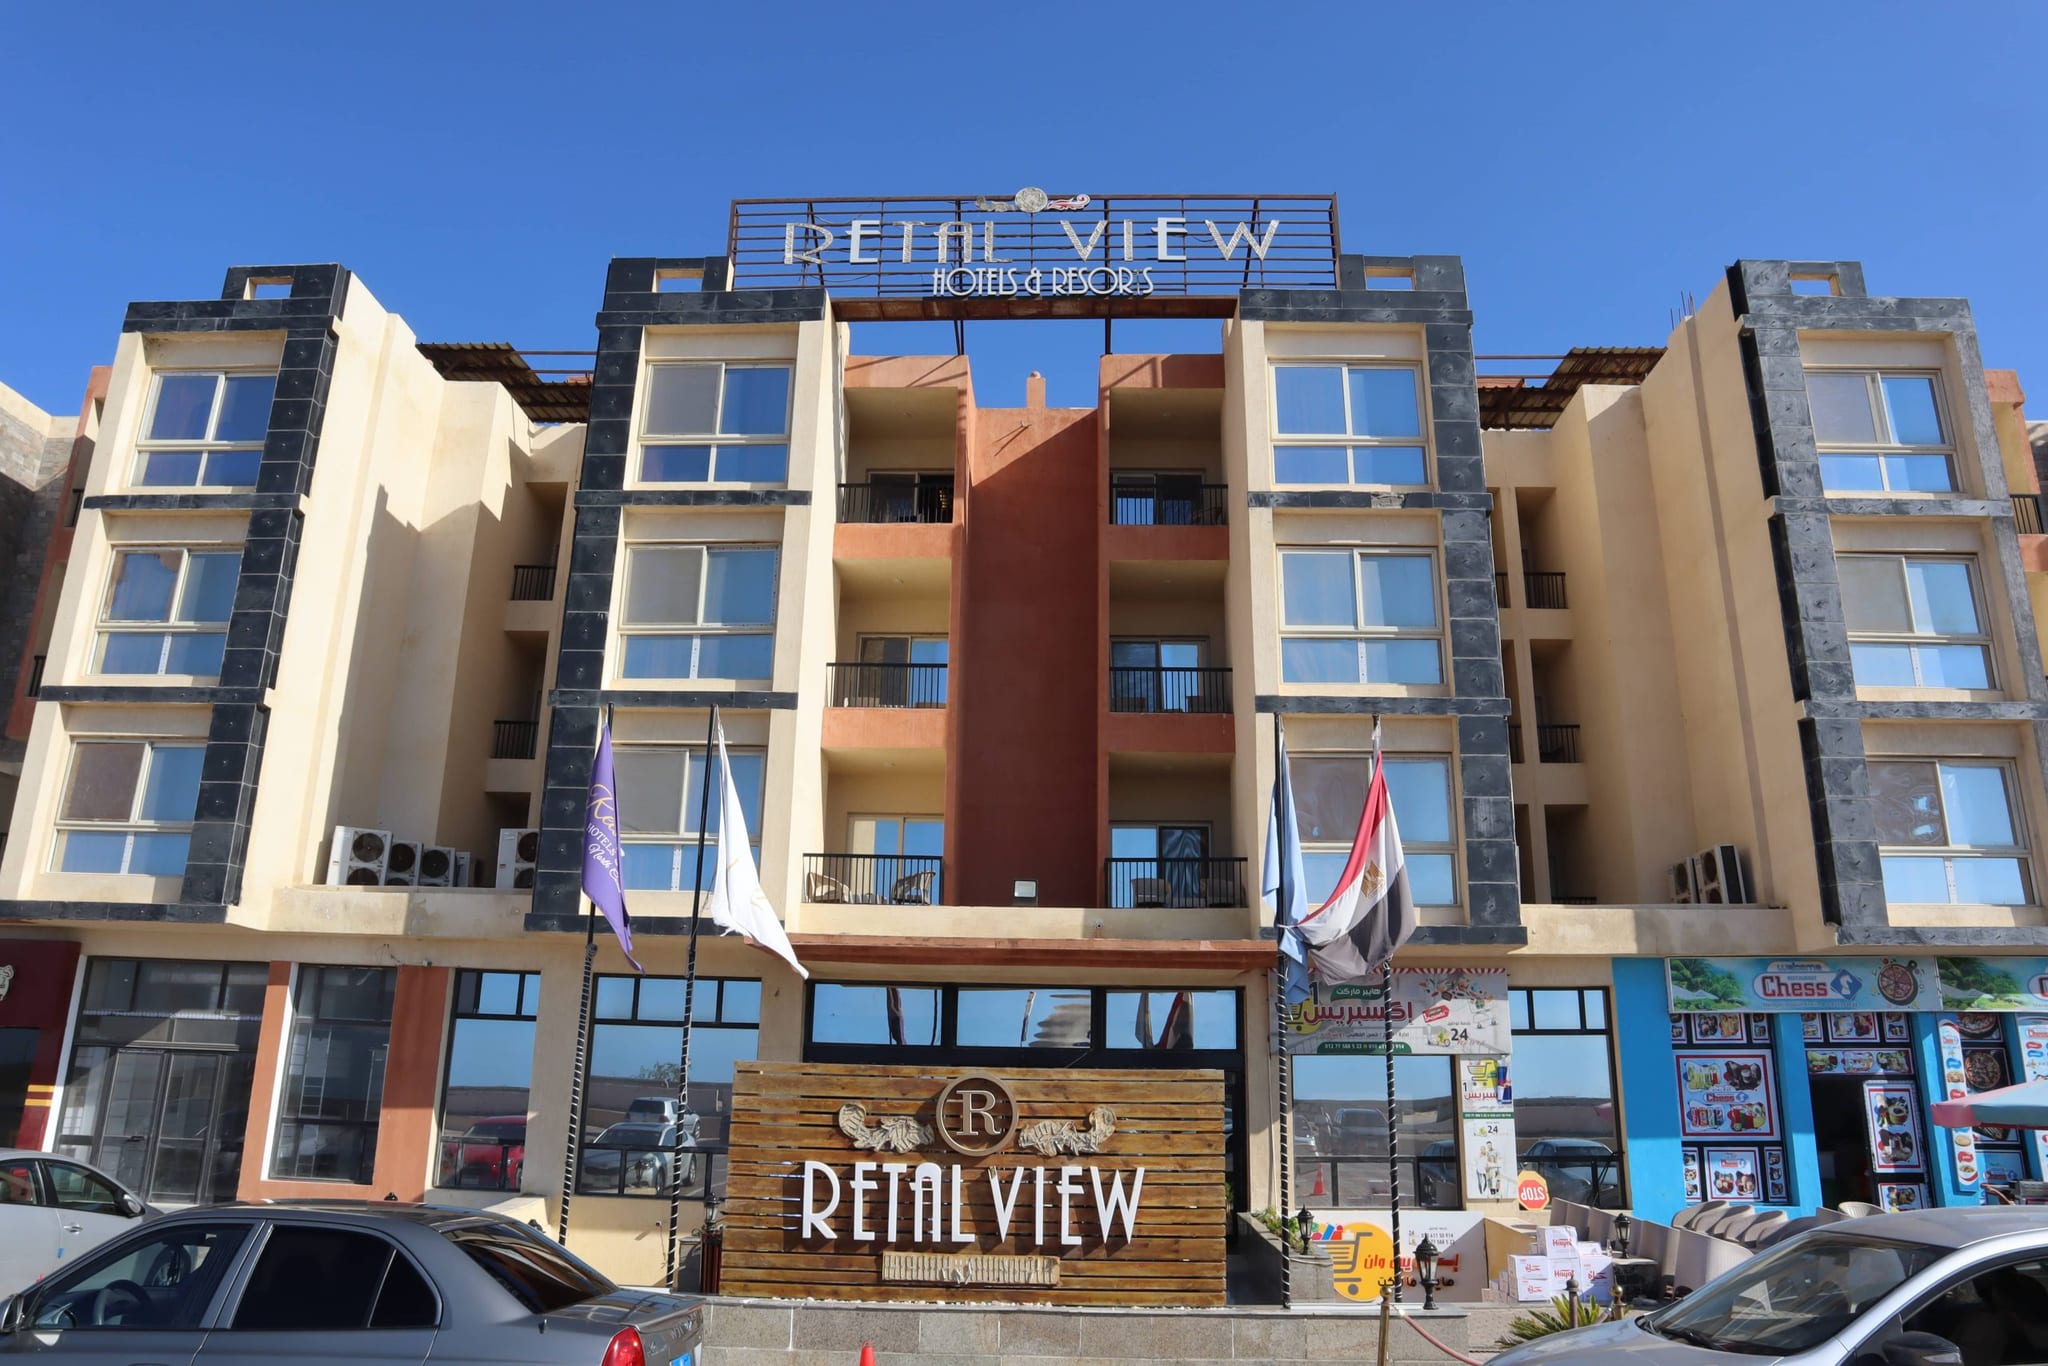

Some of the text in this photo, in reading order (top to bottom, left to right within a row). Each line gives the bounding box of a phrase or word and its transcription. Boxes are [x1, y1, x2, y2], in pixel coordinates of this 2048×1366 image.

[784, 216, 1280, 265] RETAL VIEW
[932, 266, 1018, 297] HOTELS
[1024, 266, 1042, 296] &
[1762, 975, 1829, 998] Chess
[1450, 1028, 1469, 1041] 24
[1487, 1125, 1499, 1134] 24
[801, 1160, 1146, 1246] RETAL VIEW
[1520, 1186, 1546, 1201] STOP
